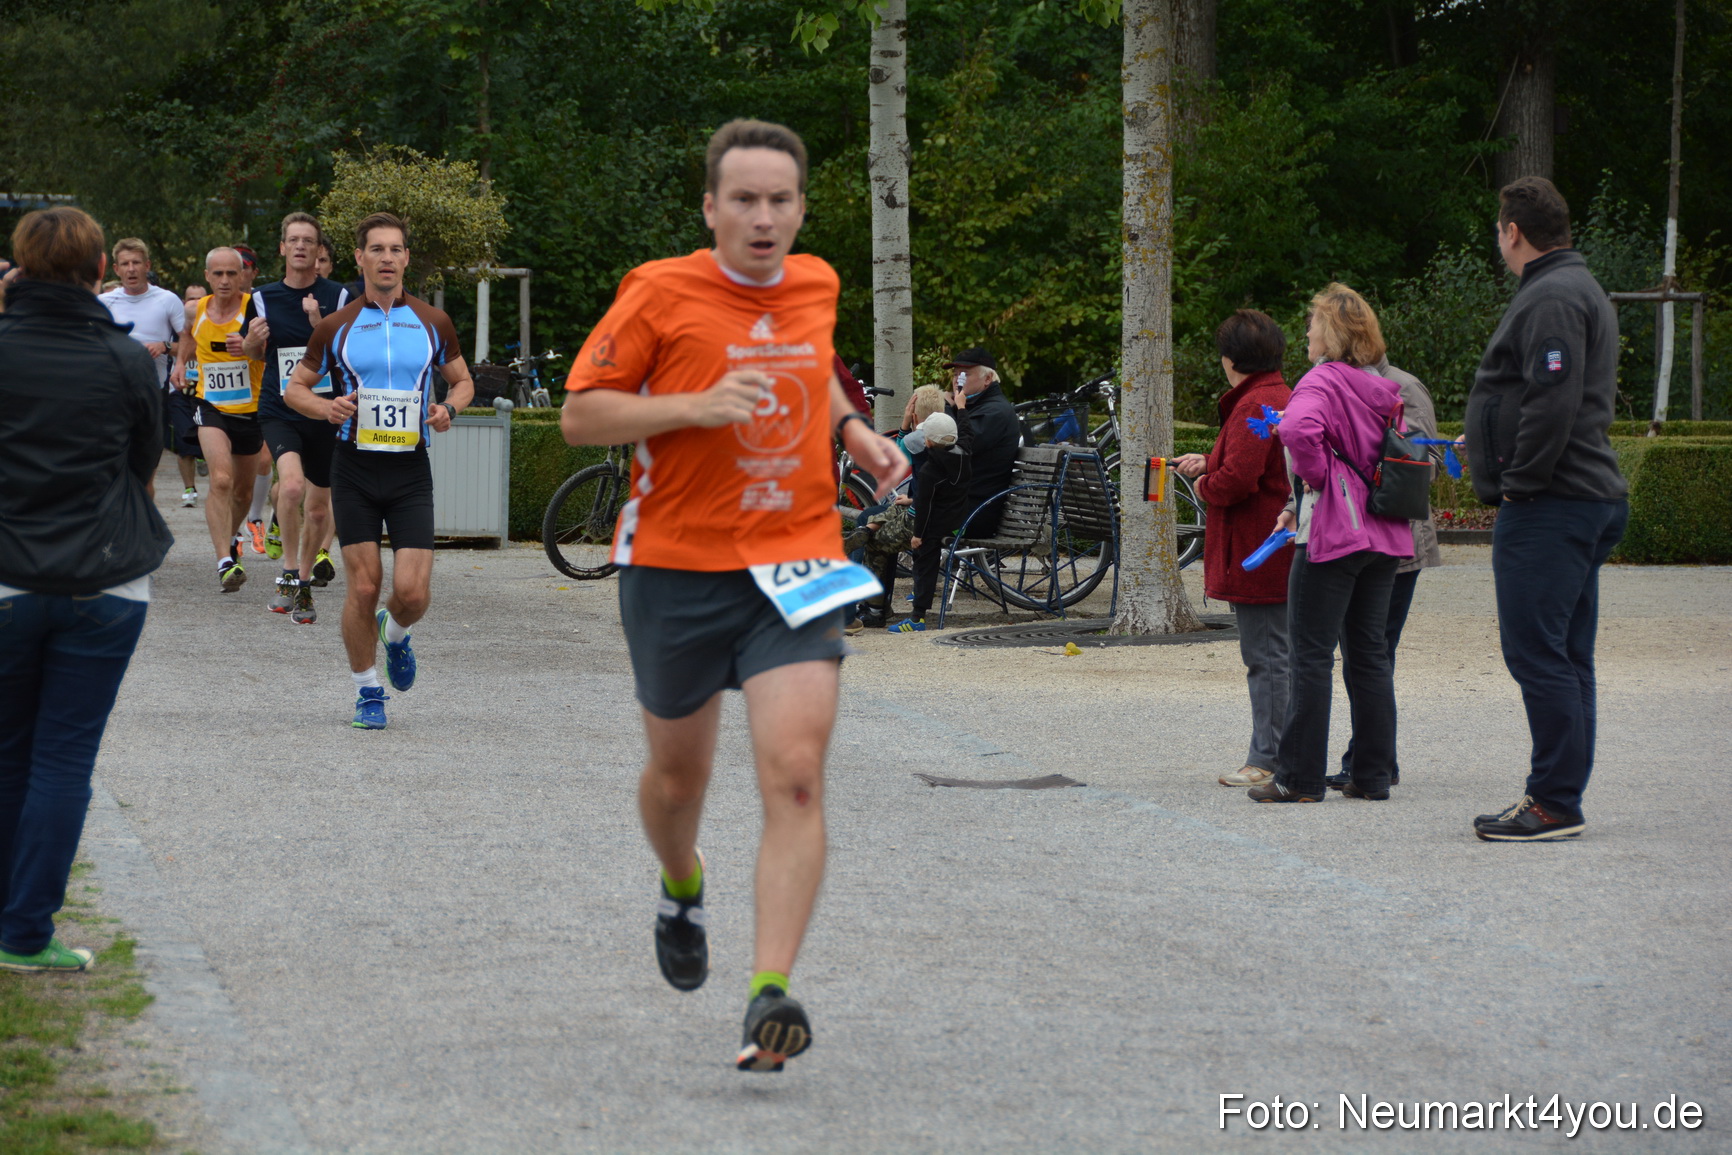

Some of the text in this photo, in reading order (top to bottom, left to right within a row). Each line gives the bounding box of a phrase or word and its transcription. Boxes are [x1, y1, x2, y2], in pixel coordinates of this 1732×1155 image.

[208, 371, 244, 389] 3011
[359, 393, 412, 403] PARTL Neumarkt
[371, 404, 407, 428] 131
[372, 432, 406, 444] Andreas
